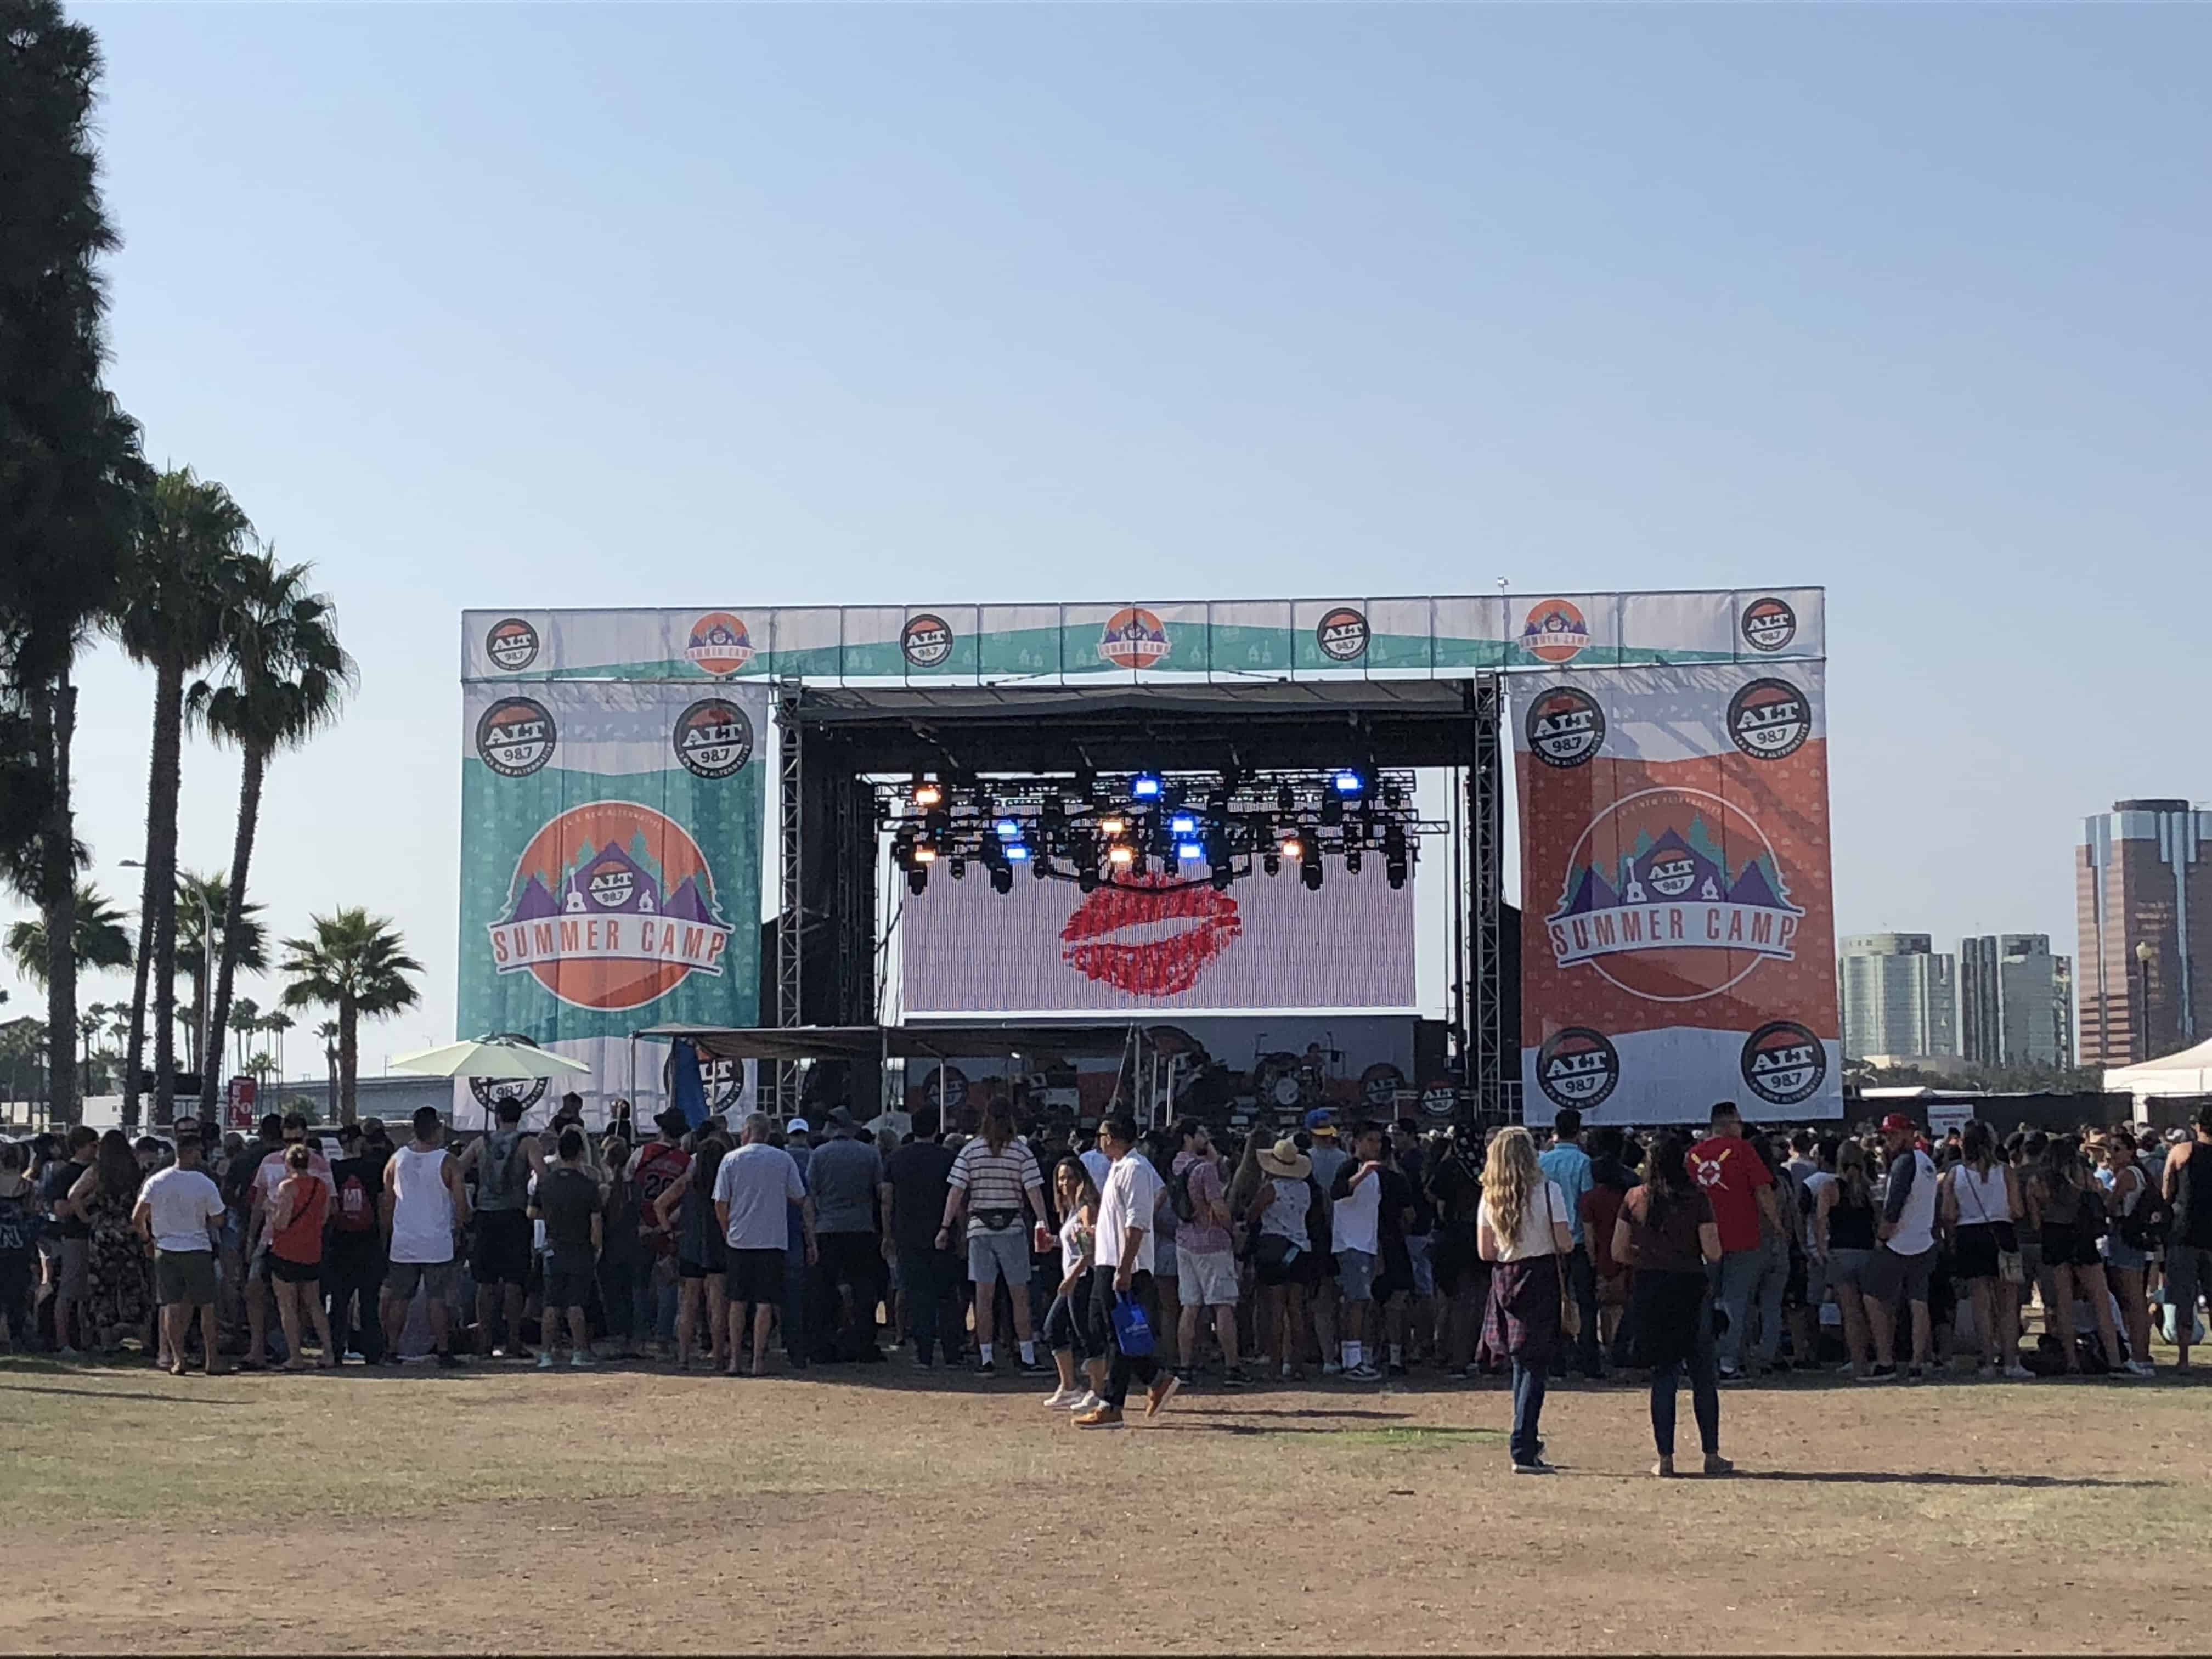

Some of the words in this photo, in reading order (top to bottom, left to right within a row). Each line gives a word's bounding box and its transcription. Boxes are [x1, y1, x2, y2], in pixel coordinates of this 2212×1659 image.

[1323, 623, 1363, 641] ALT
[1747, 614, 1788, 631] ALT
[492, 633, 532, 651] ALT
[907, 629, 945, 647] ALT
[1534, 710, 1593, 737] ALT
[1737, 702, 1799, 729] ALT
[485, 721, 545, 746] ALT
[682, 724, 742, 747] ALT
[589, 872, 633, 890] ALT
[1648, 860, 1694, 879] ALT
[493, 919, 619, 962] SUMMER
[641, 920, 728, 962] CAMP
[1551, 909, 1684, 956] SUMMER
[1707, 908, 1797, 946] CAMP
[1546, 1051, 1606, 1077] ALT
[1751, 1045, 1813, 1072] ALT
[1422, 1088, 1454, 1100] ALT
